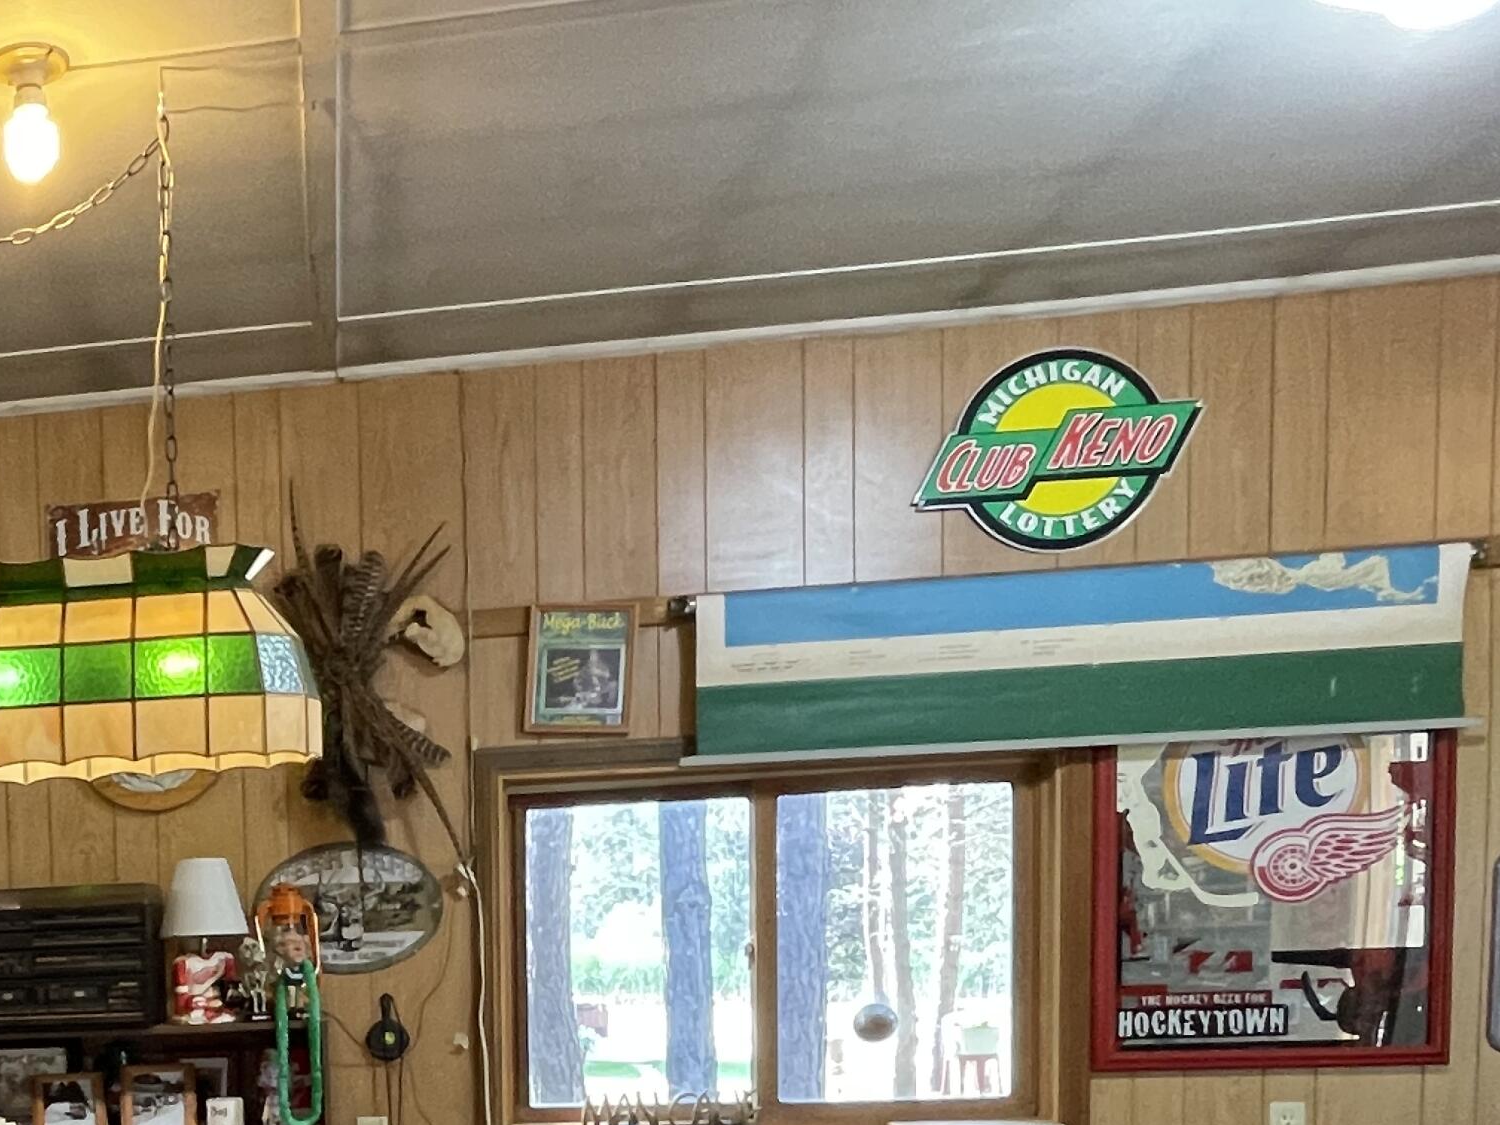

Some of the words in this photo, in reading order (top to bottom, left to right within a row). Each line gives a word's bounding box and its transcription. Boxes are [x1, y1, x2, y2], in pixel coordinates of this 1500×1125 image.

[978, 361, 1126, 425] MICHIGAN
[936, 439, 1036, 493] CLUB
[1046, 412, 1178, 470] KENO
[56, 518, 67, 557] I
[77, 507, 146, 549] LIVE
[157, 499, 211, 545] FOR
[1000, 476, 1136, 537] LOTTERY
[1187, 743, 1346, 846] Lite
[1117, 1006, 1285, 1038] HOCKEYTOWN
[1141, 995, 1162, 1006] THE
[1165, 994, 1209, 1006] HOCKEY
[1213, 993, 1242, 1005] BEER
